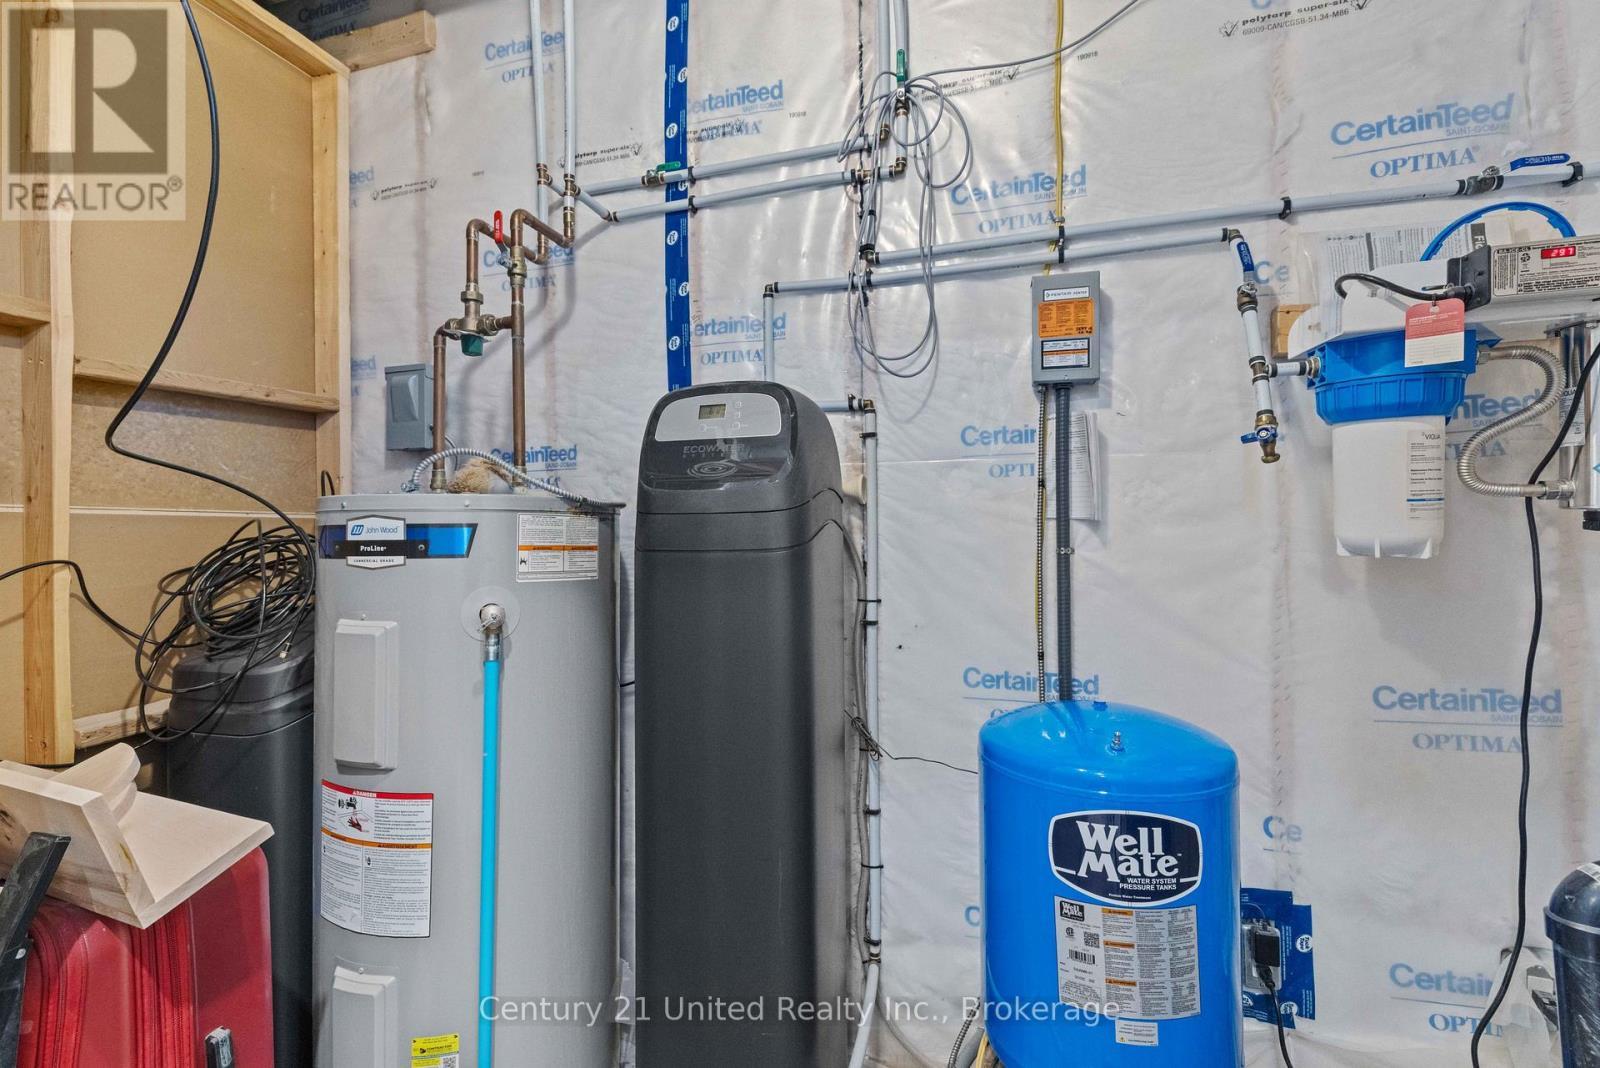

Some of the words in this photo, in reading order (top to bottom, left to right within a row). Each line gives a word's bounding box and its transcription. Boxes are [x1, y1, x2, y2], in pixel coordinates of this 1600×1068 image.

[1242, 11, 1292, 26] polytarp
[688, 80, 784, 114] ertainTeed
[1331, 93, 1515, 146] CertainTeed
[1076, 820, 1165, 856] Well
[1120, 883, 1155, 891] PRESSURE
[1152, 877, 1177, 885] SYSTEM
